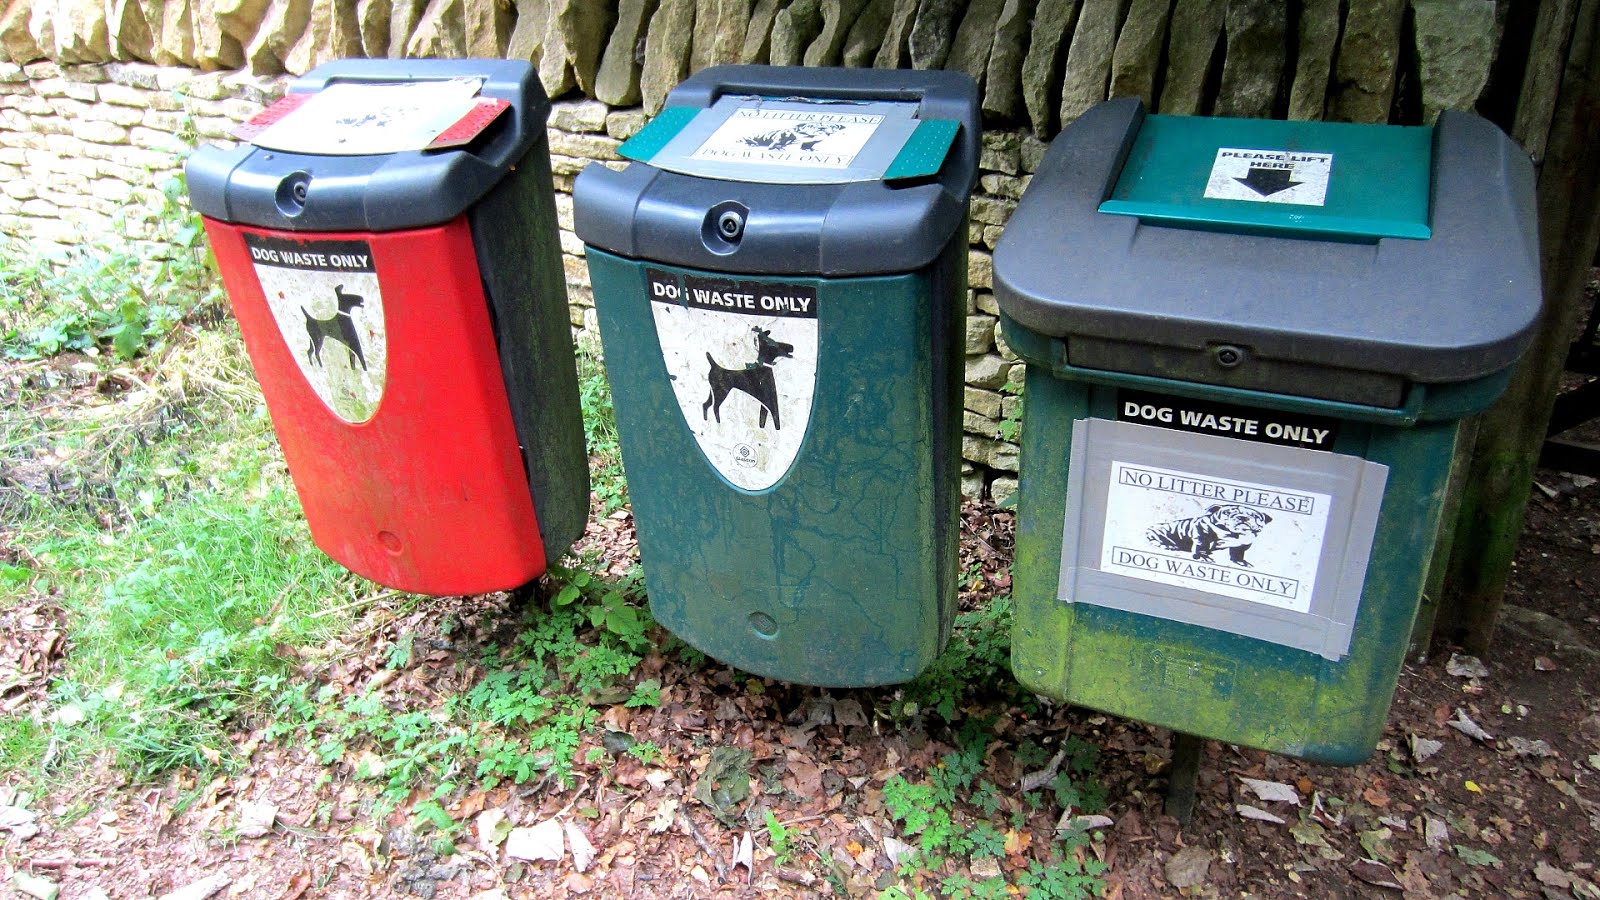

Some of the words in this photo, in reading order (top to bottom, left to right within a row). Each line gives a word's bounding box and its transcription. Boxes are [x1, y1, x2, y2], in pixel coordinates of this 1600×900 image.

[737, 110, 761, 118] NO
[762, 112, 816, 121] LITTER
[820, 114, 880, 124] PLEASE
[1221, 151, 1285, 161] PLEASE
[1290, 155, 1329, 163] LIFT
[1249, 161, 1295, 169] HERE
[251, 246, 279, 263] DOG
[280, 250, 328, 267] WASTE
[330, 254, 368, 268] ONLY
[693, 288, 755, 310] WASTE
[760, 296, 811, 313] ONLY
[1124, 401, 1173, 423] DOG
[1180, 410, 1259, 435] WASTE
[1265, 422, 1329, 445] ONLY
[1124, 470, 1152, 486] NO
[1158, 476, 1226, 499] LITTER
[1232, 488, 1311, 513] PLEASE
[1118, 551, 1159, 570] DOG
[1165, 560, 1231, 583] WASTE
[1236, 574, 1293, 595] ONLY
